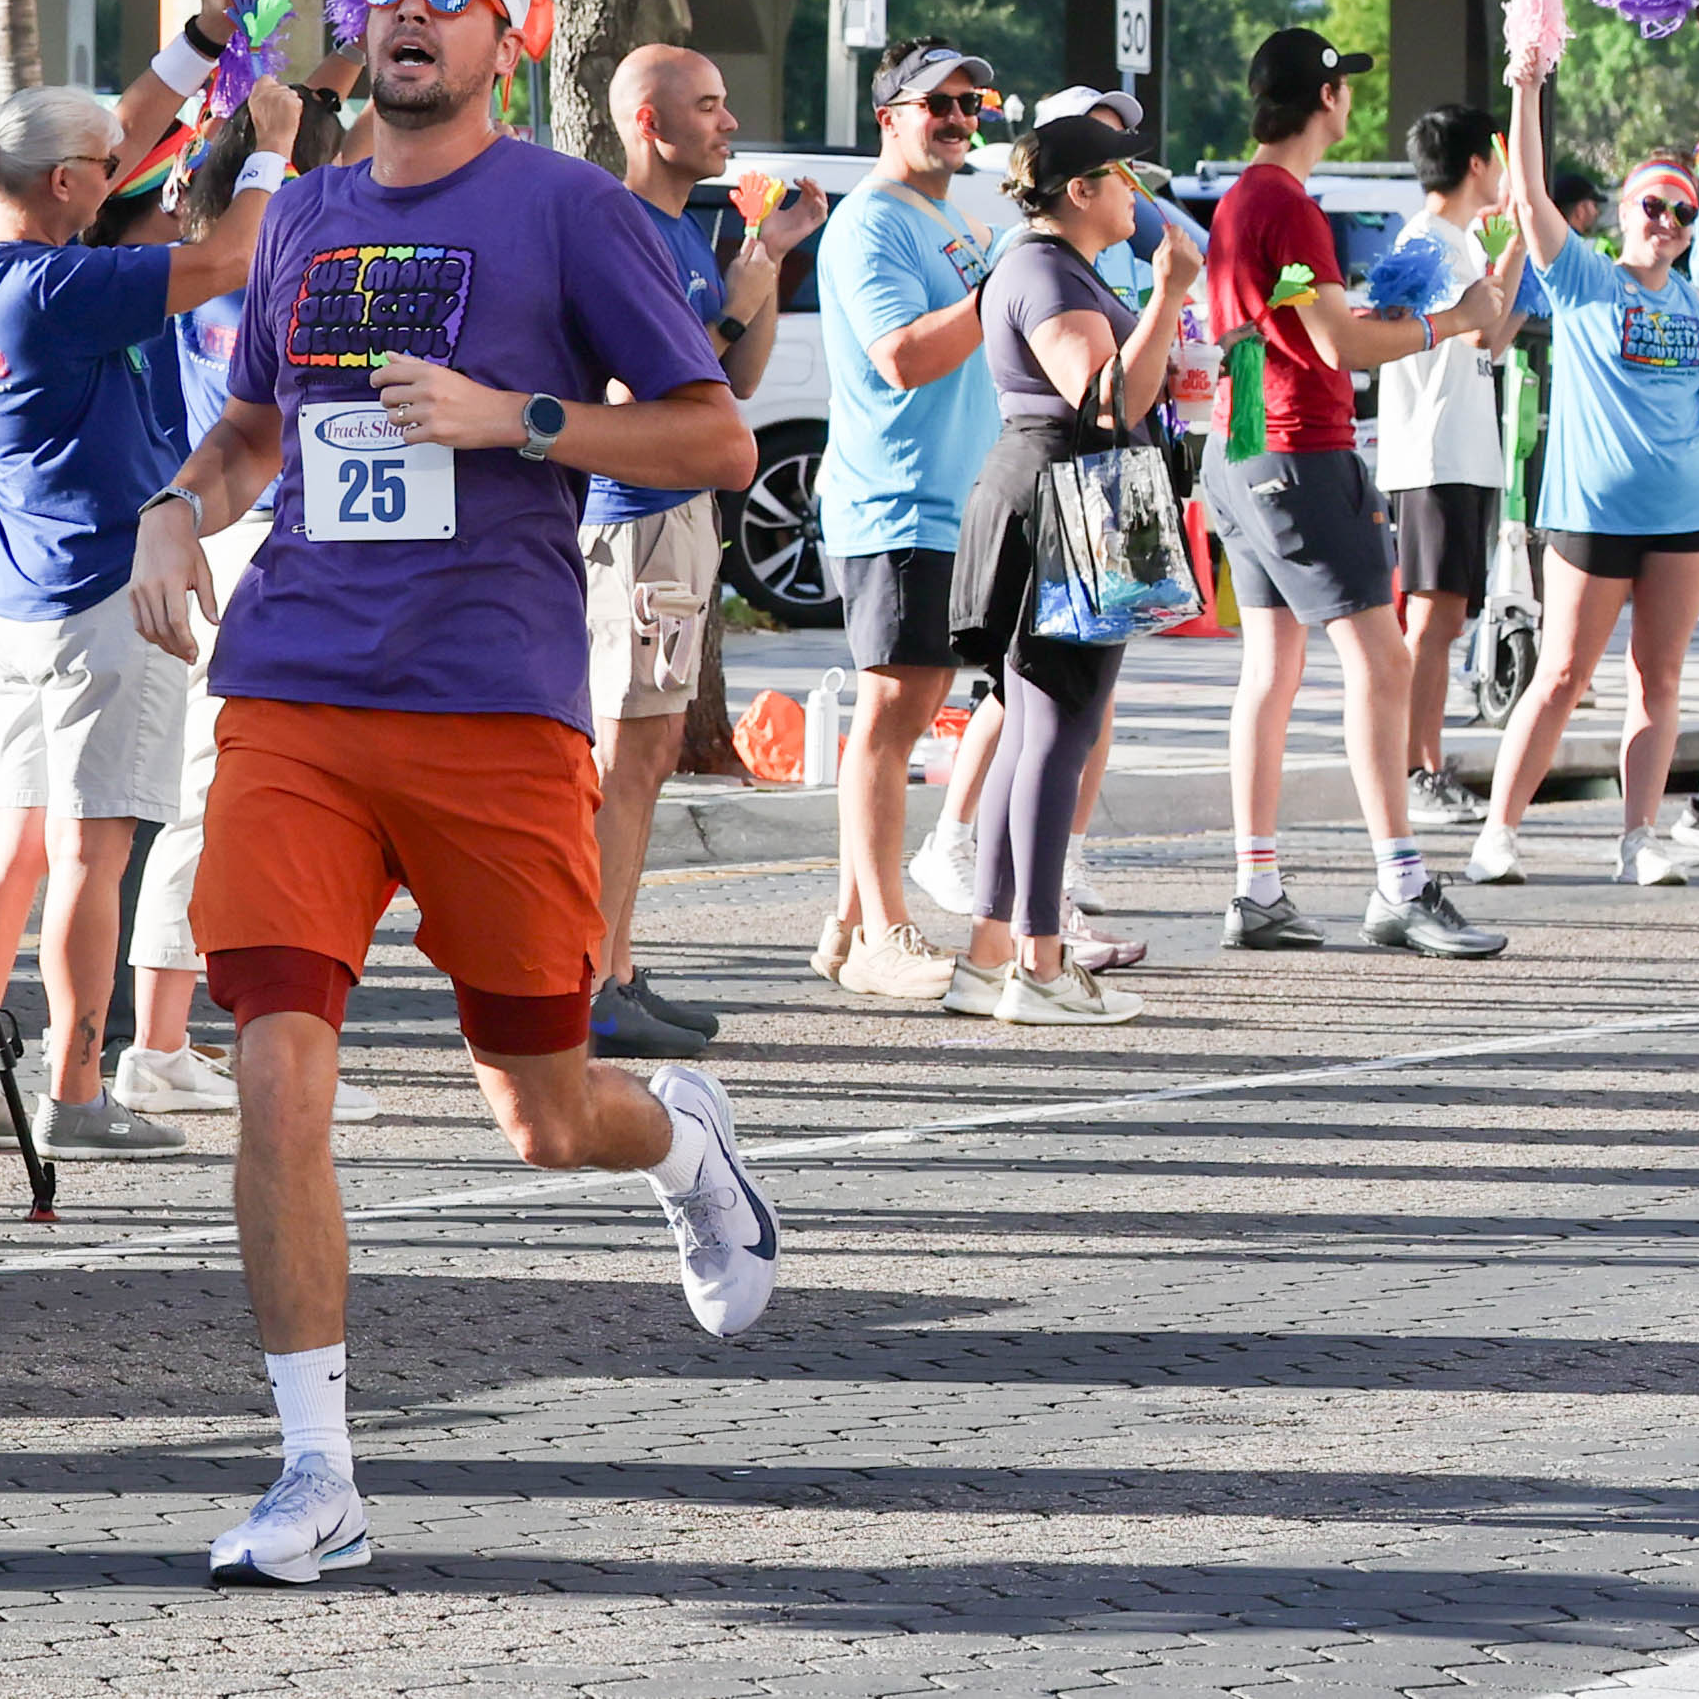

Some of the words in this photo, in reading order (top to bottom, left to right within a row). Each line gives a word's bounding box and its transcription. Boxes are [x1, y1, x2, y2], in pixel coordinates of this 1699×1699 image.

[1122, 9, 1147, 56] 30
[306, 259, 361, 294] WE
[361, 257, 467, 294] MAKE
[368, 291, 461, 326] CITY
[290, 324, 452, 359] BEAUTIFUL
[324, 419, 369, 439] Track
[369, 419, 405, 439] Sha
[338, 458, 407, 523] 25
